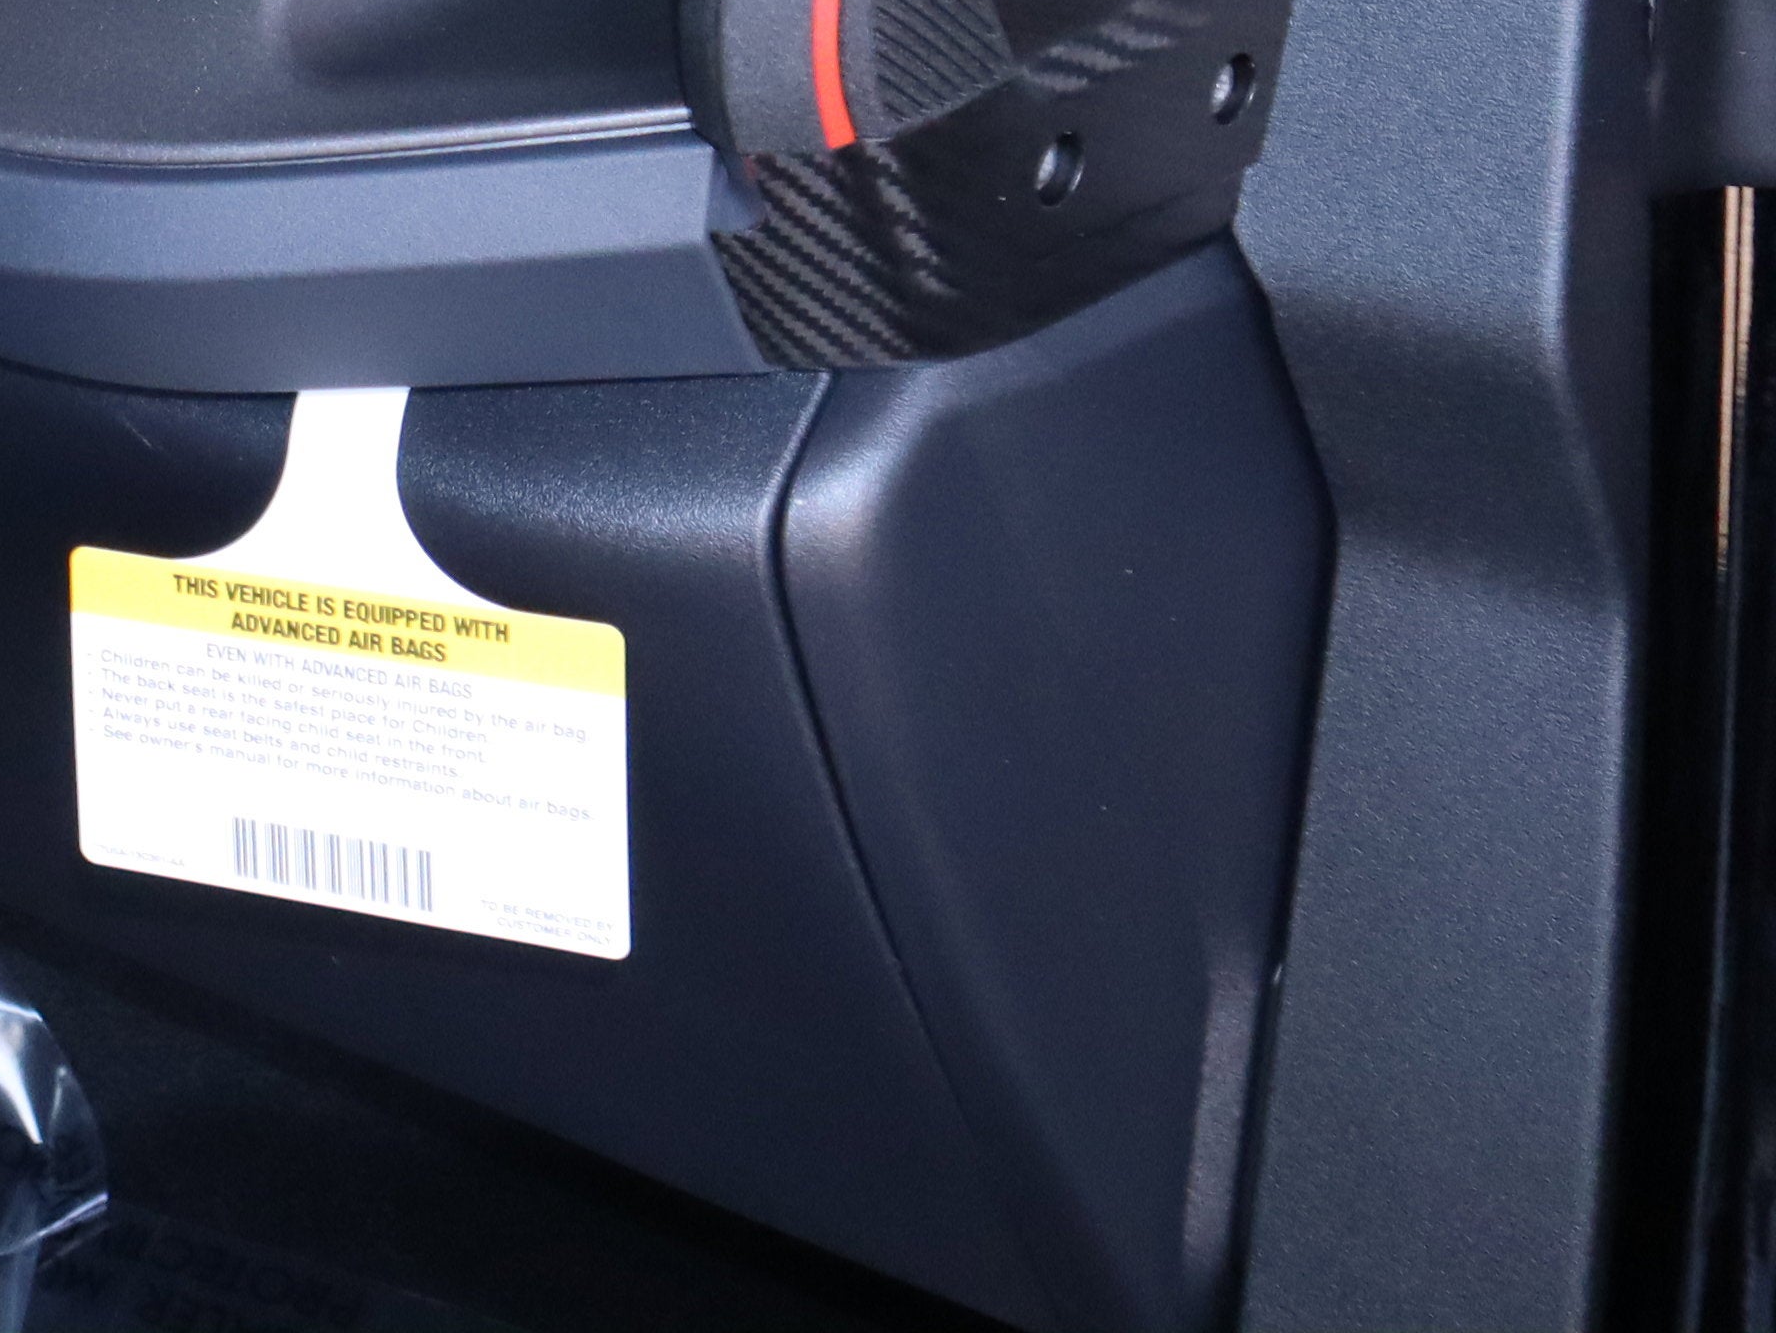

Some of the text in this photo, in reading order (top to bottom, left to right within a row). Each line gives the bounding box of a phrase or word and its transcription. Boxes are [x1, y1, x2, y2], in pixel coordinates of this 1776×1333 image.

[173, 574, 510, 643] THIS VEHICLE IS EQUIPPED WITH
[231, 611, 446, 663] ADVANCED AIR BAGS
[101, 649, 170, 671] Children
[176, 665, 206, 677] can
[212, 668, 231, 683] be
[238, 673, 282, 691] killed
[288, 683, 304, 694] or
[312, 686, 390, 711] seriously
[398, 701, 457, 719] injured
[464, 709, 482, 726] by
[491, 714, 518, 729] the
[525, 719, 547, 732] air
[101, 667, 131, 685] The
[137, 675, 176, 692] back
[182, 685, 216, 699] seat
[221, 688, 236, 703] is
[242, 693, 267, 708] the
[274, 700, 324, 718] safest
[331, 709, 376, 726] place
[382, 715, 405, 729] for
[206, 643, 472, 700] EVEN WITH ADVANCED AIR BAGS
[102, 687, 148, 706] Never
[156, 698, 181, 715] put
[188, 704, 196, 715] a
[202, 707, 233, 720] rear
[240, 711, 292, 734] facing
[298, 723, 339, 739] child
[346, 731, 381, 746] seat
[387, 735, 403, 749] in
[409, 740, 435, 755] the
[103, 707, 161, 728] Always
[168, 722, 196, 734] use
[203, 726, 237, 740] seat
[243, 731, 283, 749] belts
[290, 741, 321, 755] and
[328, 747, 368, 763] child
[104, 724, 133, 742] See
[210, 745, 270, 765] manual
[277, 754, 299, 769] for
[306, 762, 349, 779] more
[356, 771, 455, 795] information
[462, 788, 511, 807] about
[519, 797, 541, 810] air
[503, 903, 519, 915] BE
